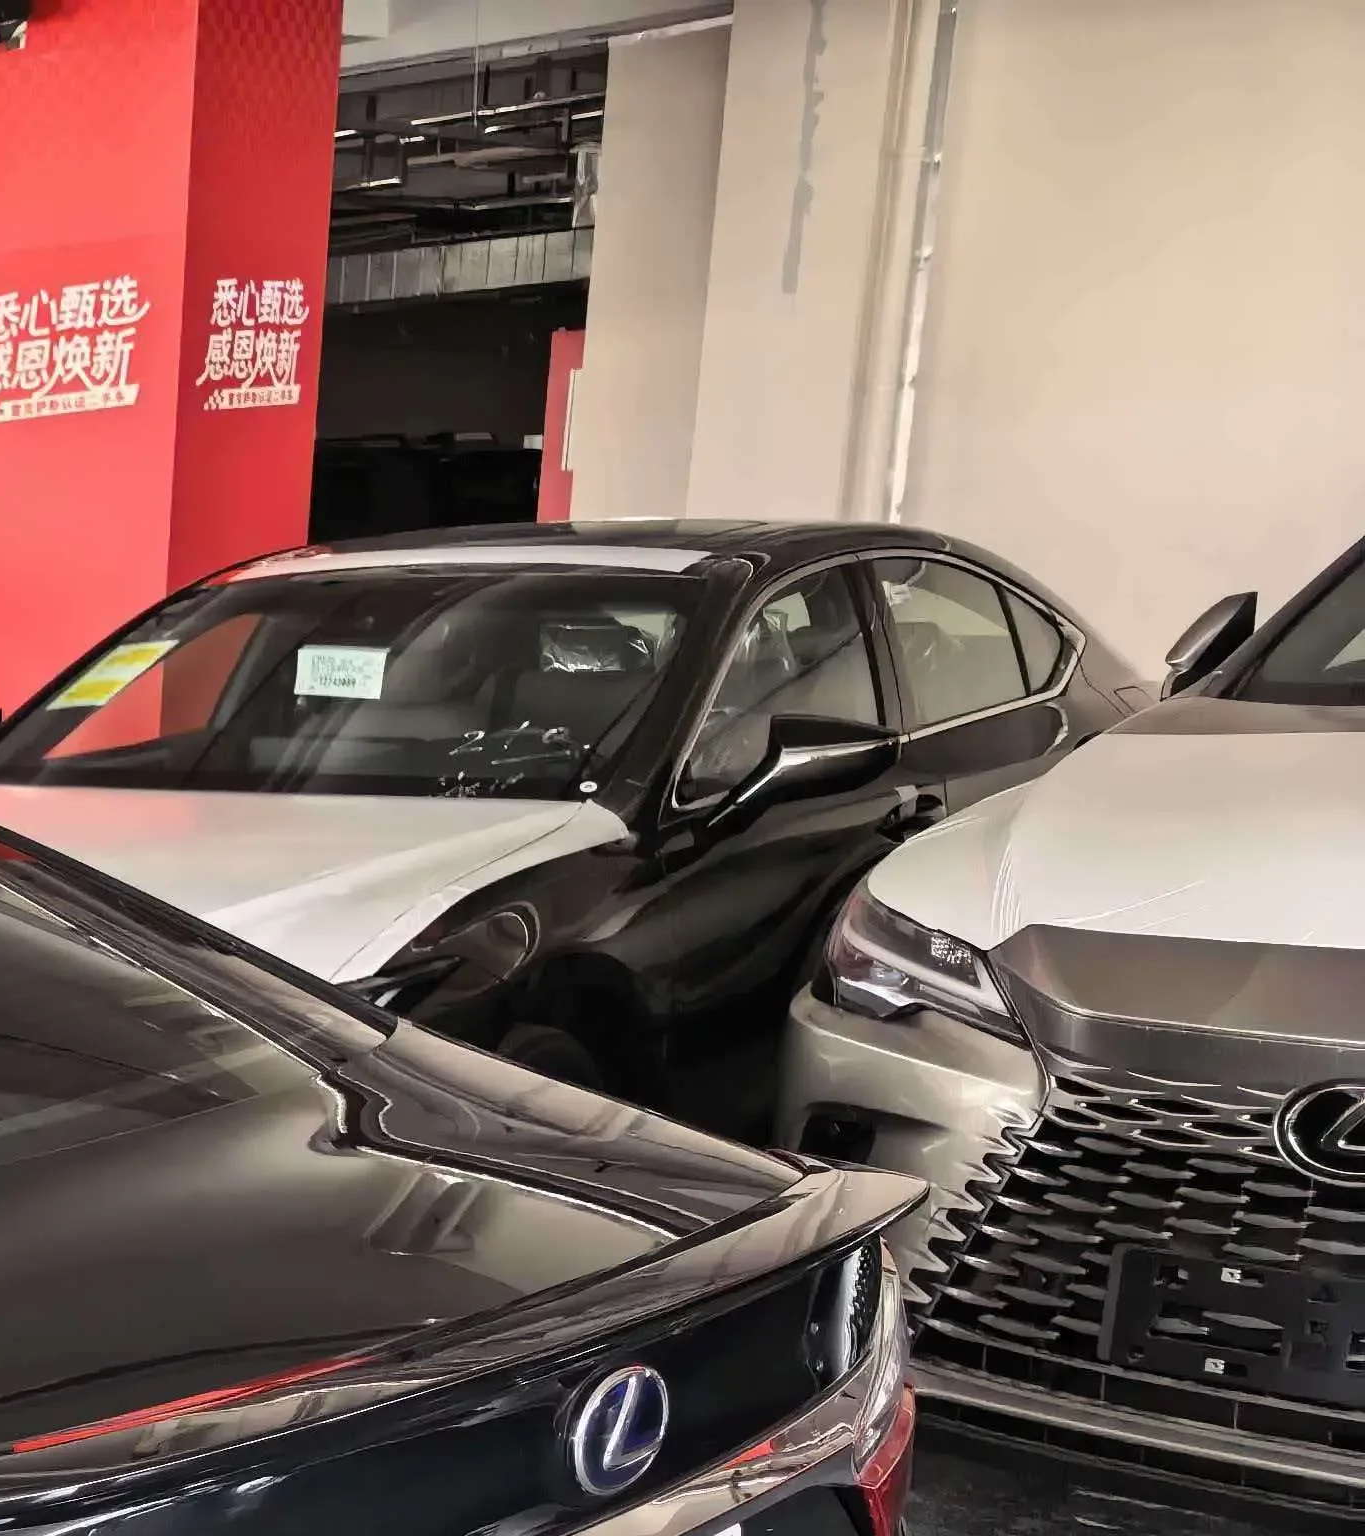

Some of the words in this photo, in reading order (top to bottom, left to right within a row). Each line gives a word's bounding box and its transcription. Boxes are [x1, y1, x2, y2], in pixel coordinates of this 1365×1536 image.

[209, 277, 310, 329] 悉心甄选
[195, 327, 302, 387] 感恩焕新
